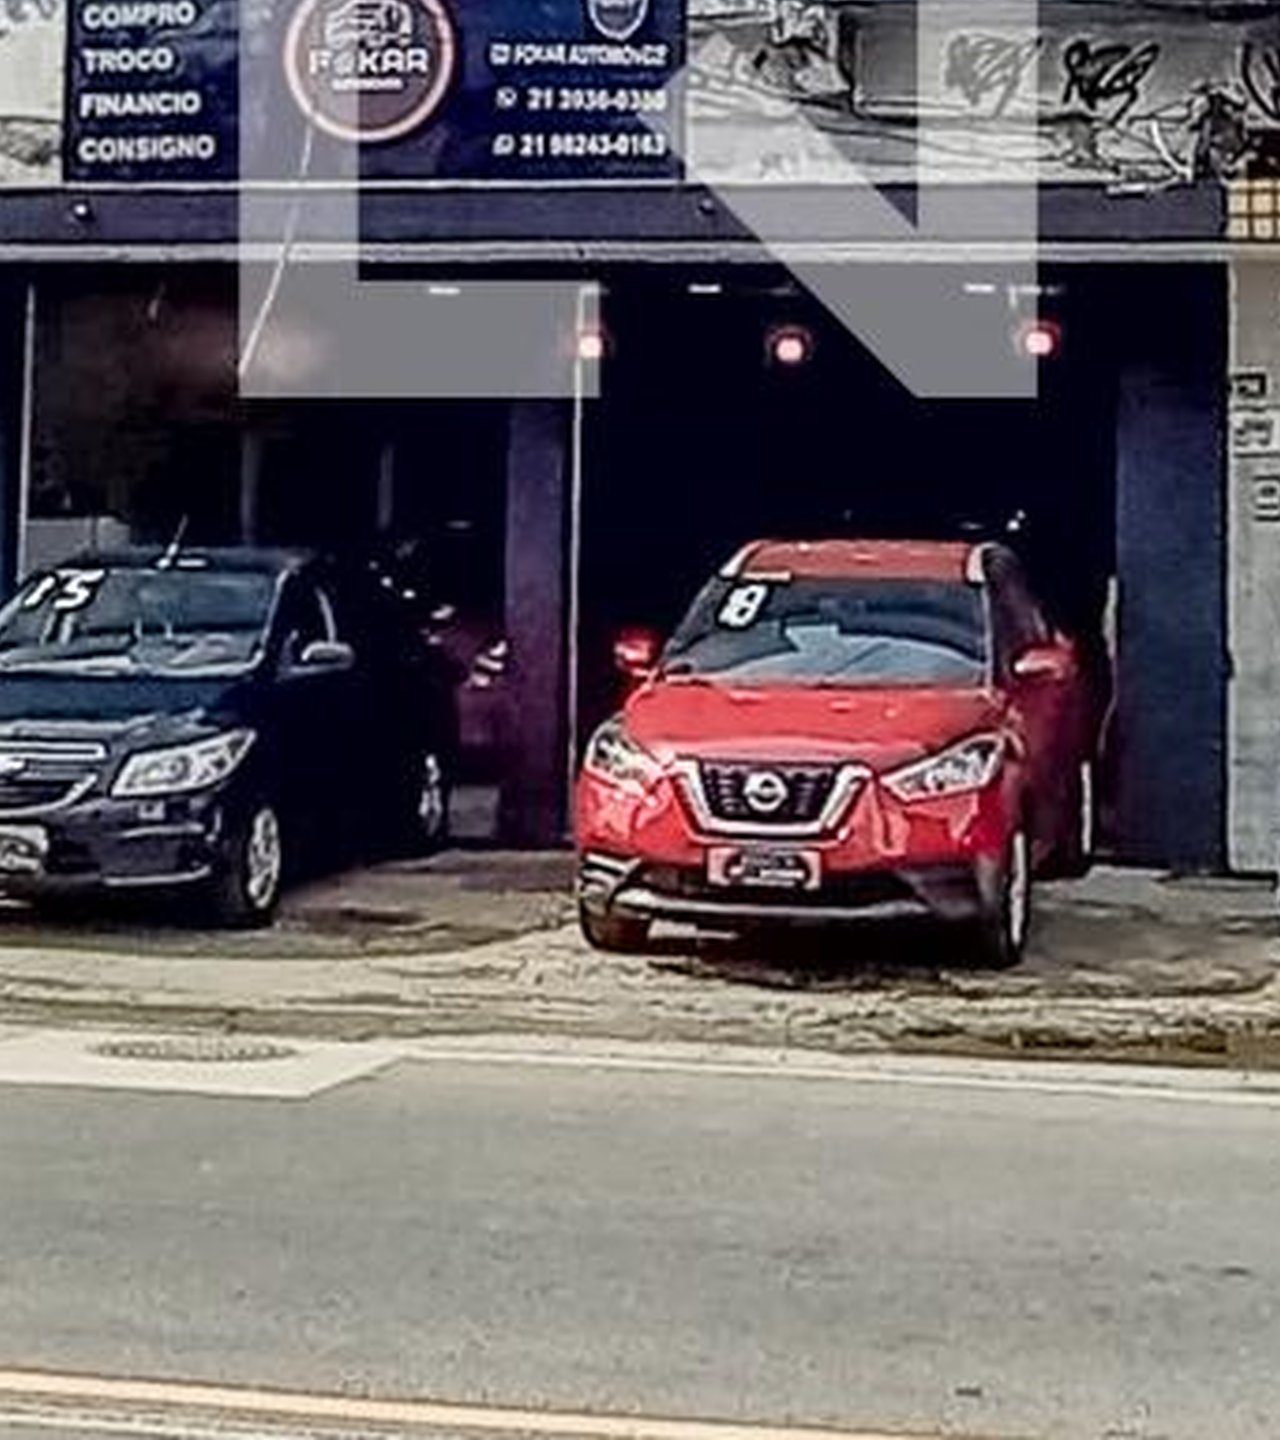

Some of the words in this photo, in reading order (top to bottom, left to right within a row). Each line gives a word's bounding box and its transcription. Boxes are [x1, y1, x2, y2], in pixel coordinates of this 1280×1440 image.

[83, 0, 196, 29] COMPRO
[81, 46, 174, 74] TROCO
[79, 90, 201, 118] FINANCIO
[78, 134, 216, 163] CONSIGNO
[519, 133, 545, 157] 21
[24, 568, 105, 609] 15
